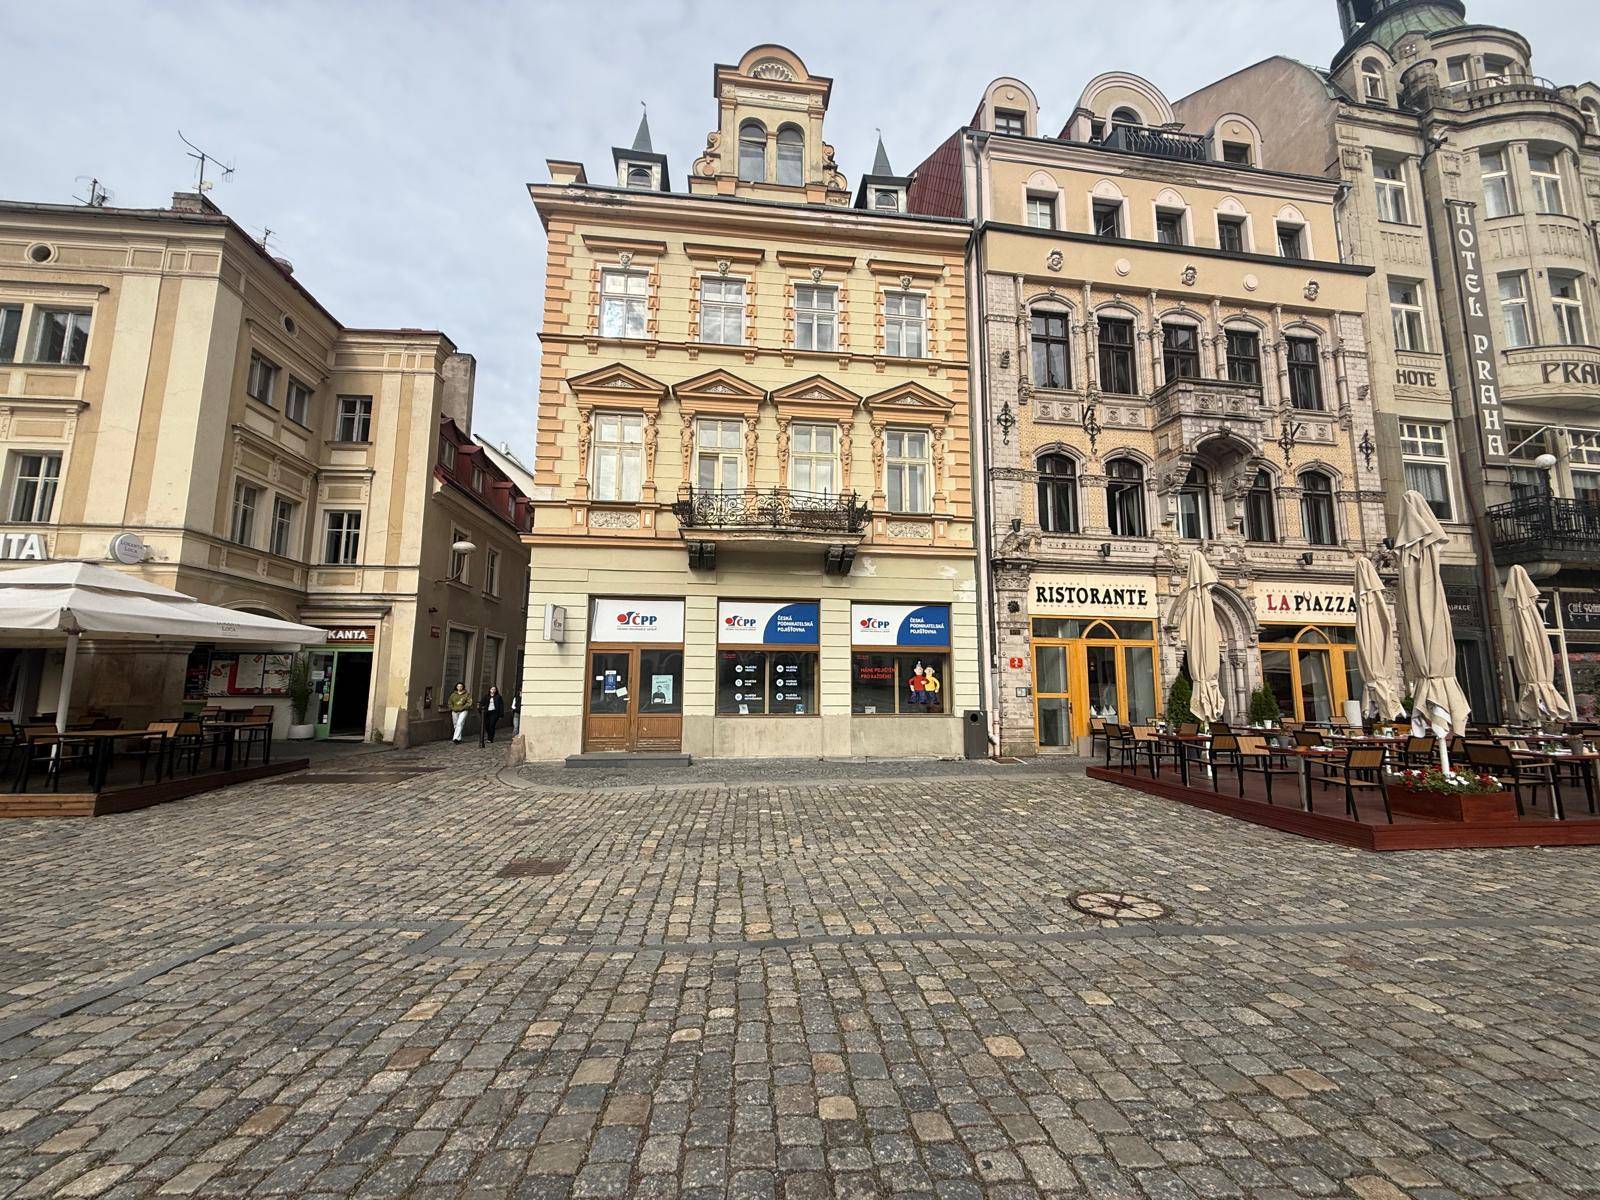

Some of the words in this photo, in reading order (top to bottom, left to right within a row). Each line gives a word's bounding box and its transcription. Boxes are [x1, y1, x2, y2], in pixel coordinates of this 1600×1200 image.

[1454, 205, 1484, 317] HOTEL
[1473, 334, 1505, 456] PRAHA
[1541, 362, 1600, 384] PRA
[0, 533, 44, 560] TA
[1035, 586, 1148, 606] RISTORANTE
[1266, 594, 1291, 611] LA
[1293, 591, 1357, 613] PIAZZA
[632, 612, 657, 625] ČPP
[736, 616, 757, 627] ČPP
[871, 619, 890, 629] ČPP
